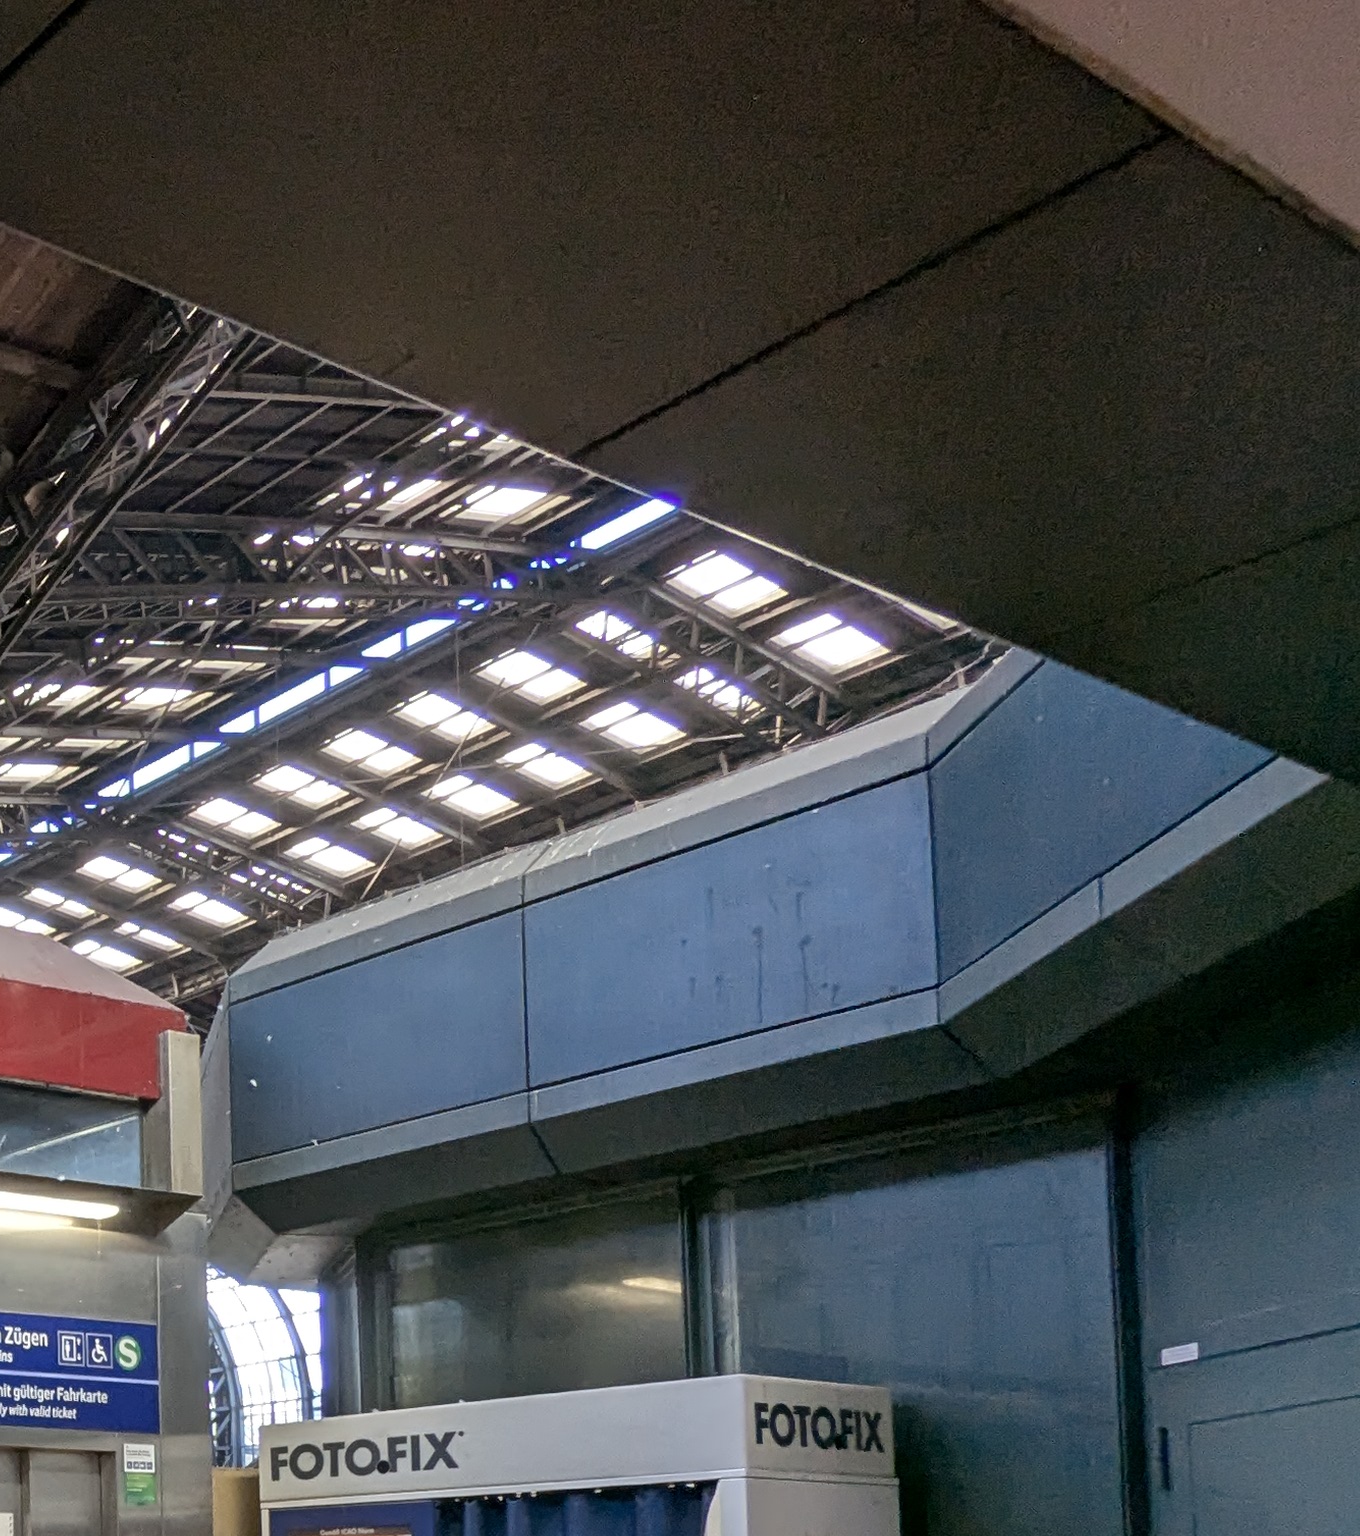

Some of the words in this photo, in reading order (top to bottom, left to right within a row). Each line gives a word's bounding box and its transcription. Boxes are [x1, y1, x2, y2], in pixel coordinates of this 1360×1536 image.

[4, 1326, 48, 1349] Zügen
[118, 1337, 138, 1369] S
[13, 1383, 55, 1403] gültiger
[57, 1386, 108, 1404] Fahrkarte
[9, 1403, 28, 1417] with
[29, 1405, 51, 1418] valid
[52, 1406, 77, 1420] ticket
